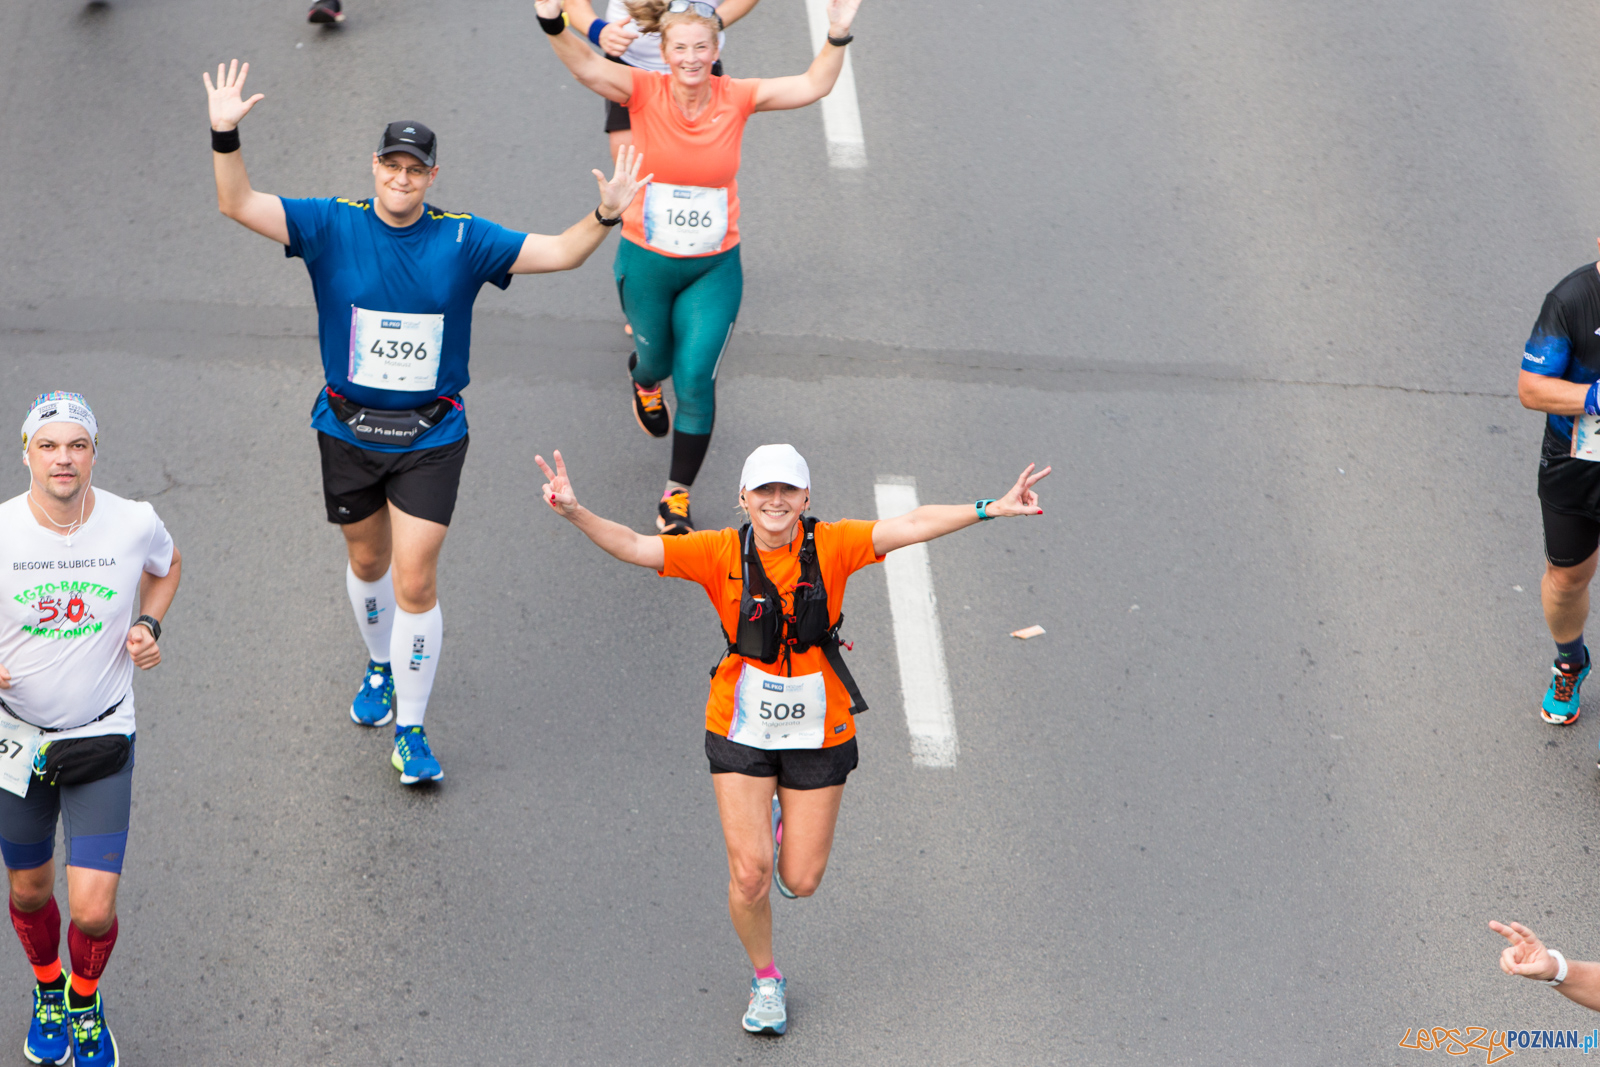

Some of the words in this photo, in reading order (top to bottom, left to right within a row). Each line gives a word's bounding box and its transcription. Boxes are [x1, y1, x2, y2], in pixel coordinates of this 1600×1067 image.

[666, 208, 712, 228] 1686
[370, 339, 427, 361] 4396
[374, 427, 418, 437] Kalenji
[13, 561, 55, 570] BIEGOWE
[57, 559, 96, 569] SŁUBICE
[98, 557, 116, 567] DLA
[13, 580, 118, 605] EGZO-BARTEK
[38, 597, 85, 623] 50
[21, 621, 103, 640] MARATONÓW
[759, 700, 806, 720] 508
